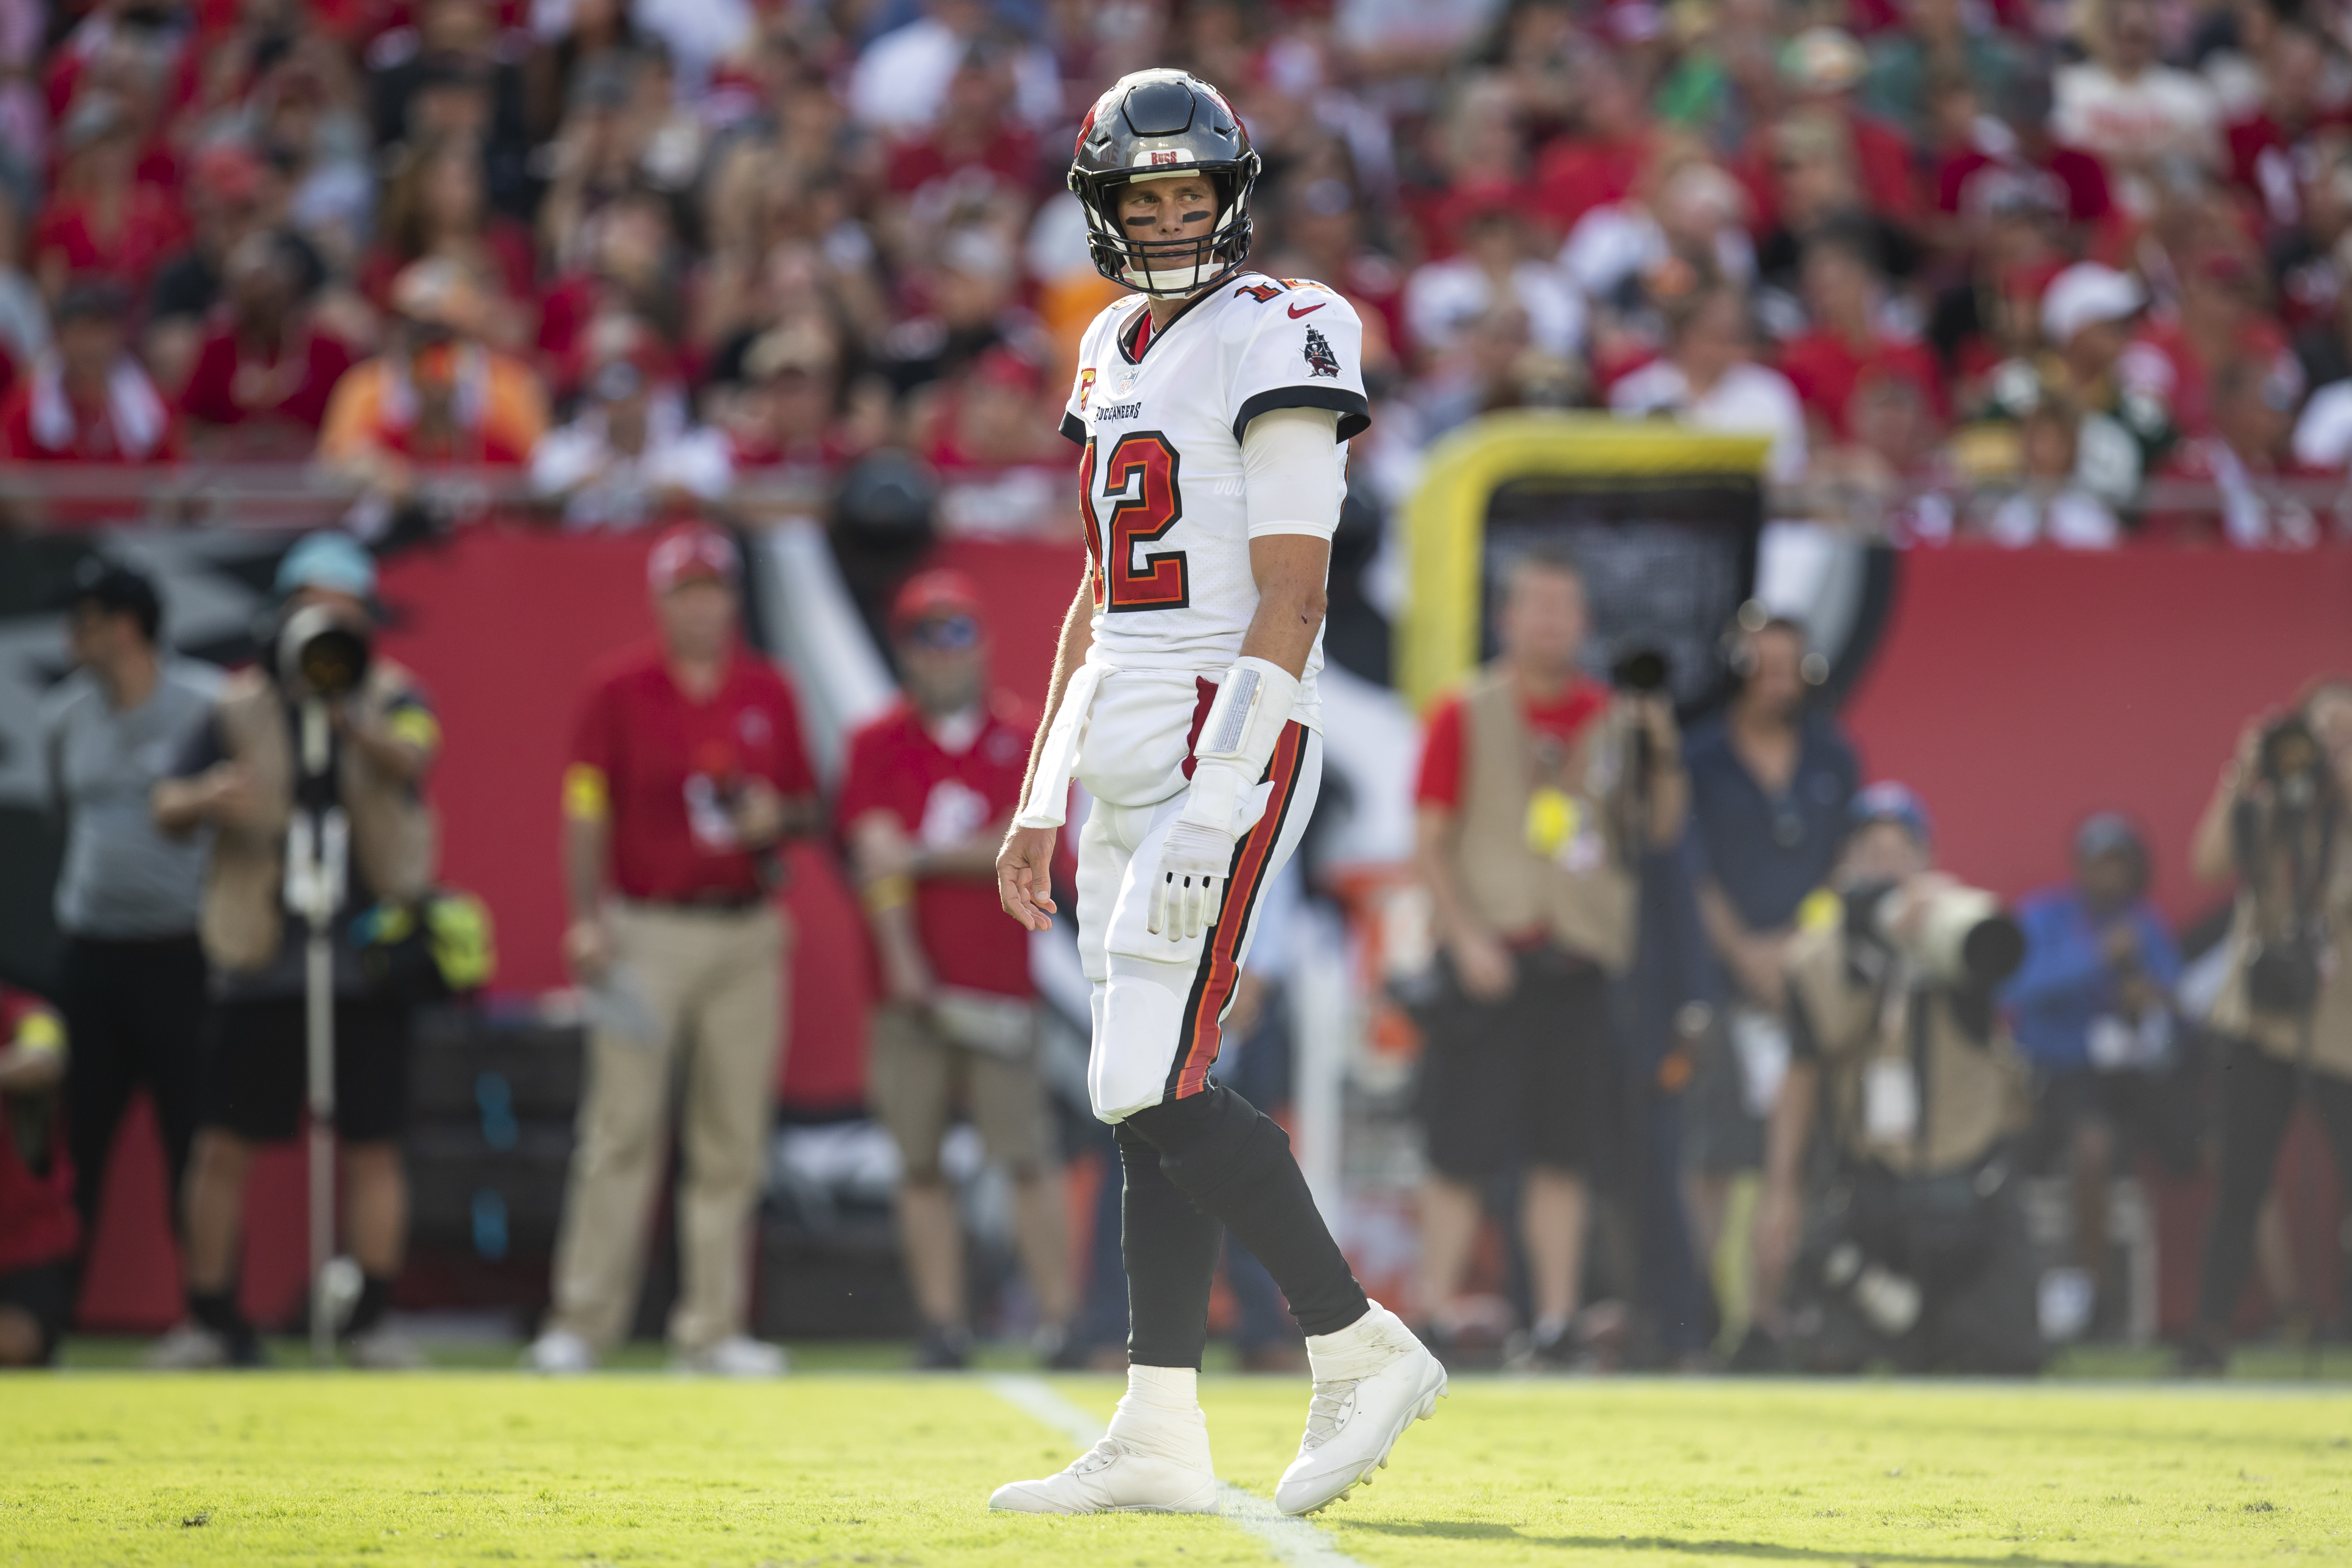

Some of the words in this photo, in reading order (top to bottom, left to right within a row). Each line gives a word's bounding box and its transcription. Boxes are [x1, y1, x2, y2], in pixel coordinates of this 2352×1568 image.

[1151, 151, 1177, 165] BUCS
[1120, 380, 1131, 391] NFL
[1094, 402, 1142, 423] BUCCANEERS
